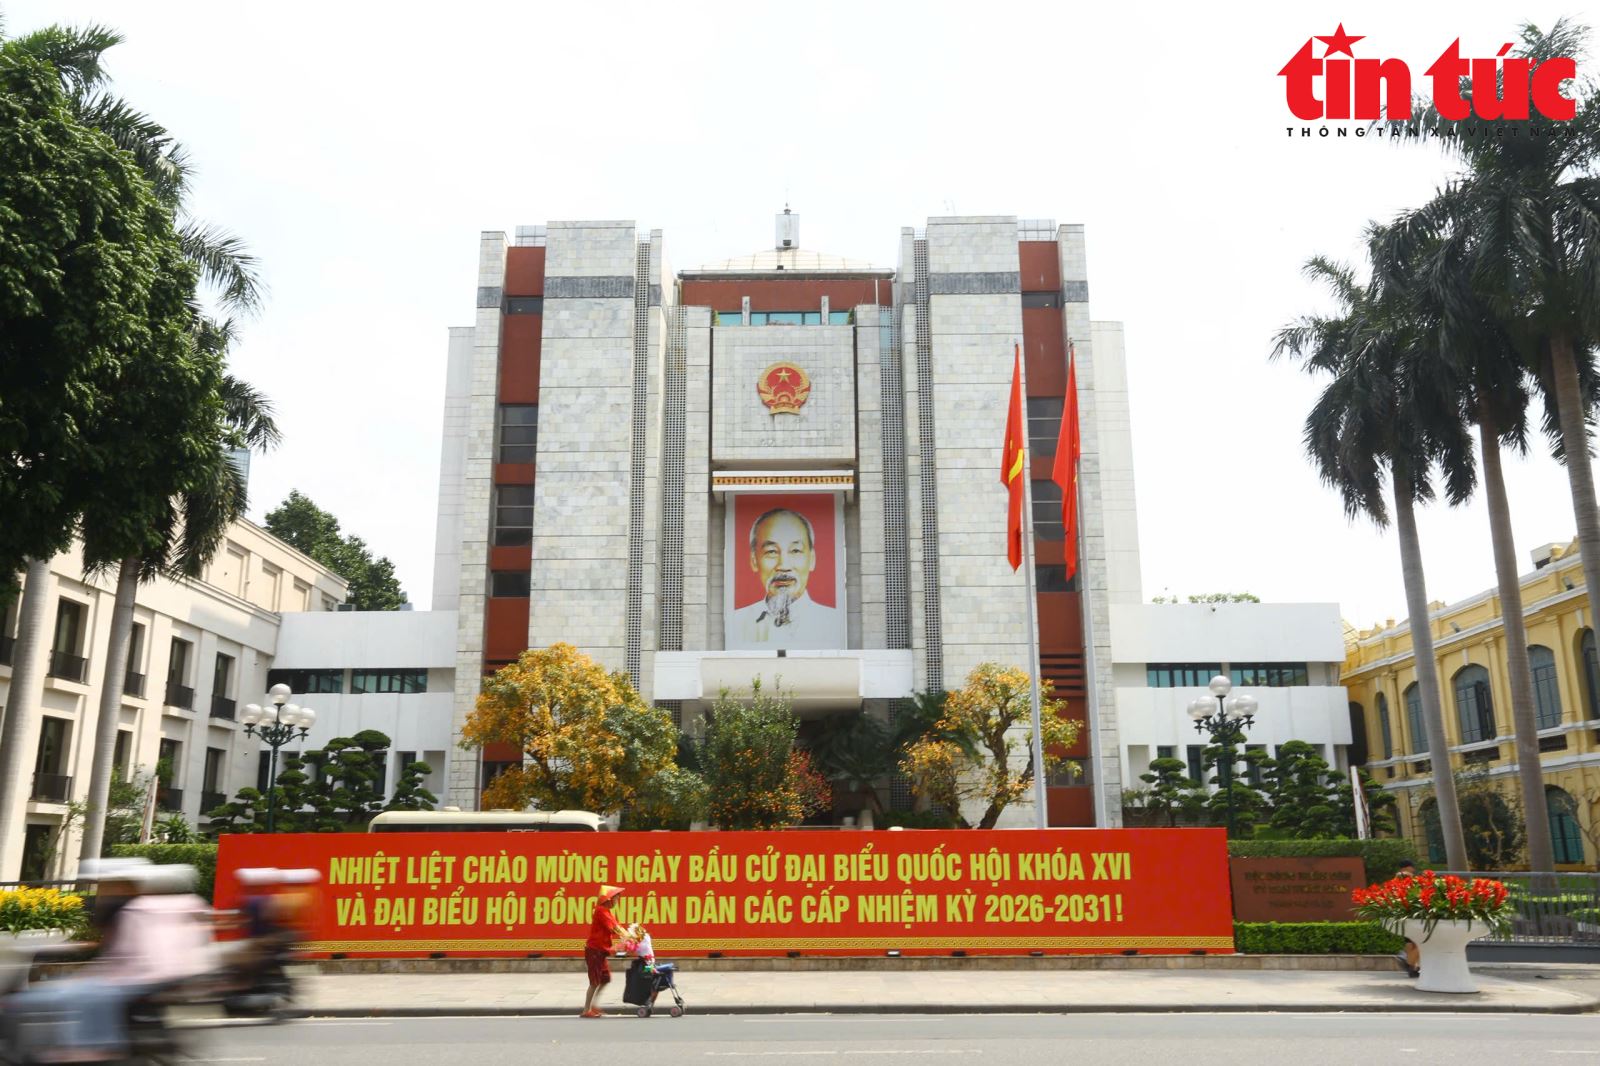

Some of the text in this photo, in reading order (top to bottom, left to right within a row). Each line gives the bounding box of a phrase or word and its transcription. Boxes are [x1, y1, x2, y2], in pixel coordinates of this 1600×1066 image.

[329, 844, 1131, 891] NHIỆT LIỆT CHÀO MỪNG NGÀY BẦU CỬ ĐẠI BIỂU QUỐC HỘI KHÓA XVI
[337, 891, 366, 926] VÀ
[374, 897, 415, 932] ĐẠI
[423, 886, 478, 926] BIỂU
[486, 890, 527, 932] HỘI
[610, 890, 678, 924] NHÂN
[685, 889, 737, 924] DÂN
[744, 889, 793, 924] CÁC
[800, 885, 850, 924] CẤP
[858, 888, 938, 930] NHIỆM
[946, 888, 977, 923] KỲ
[984, 894, 1124, 923] 2026-2031!
